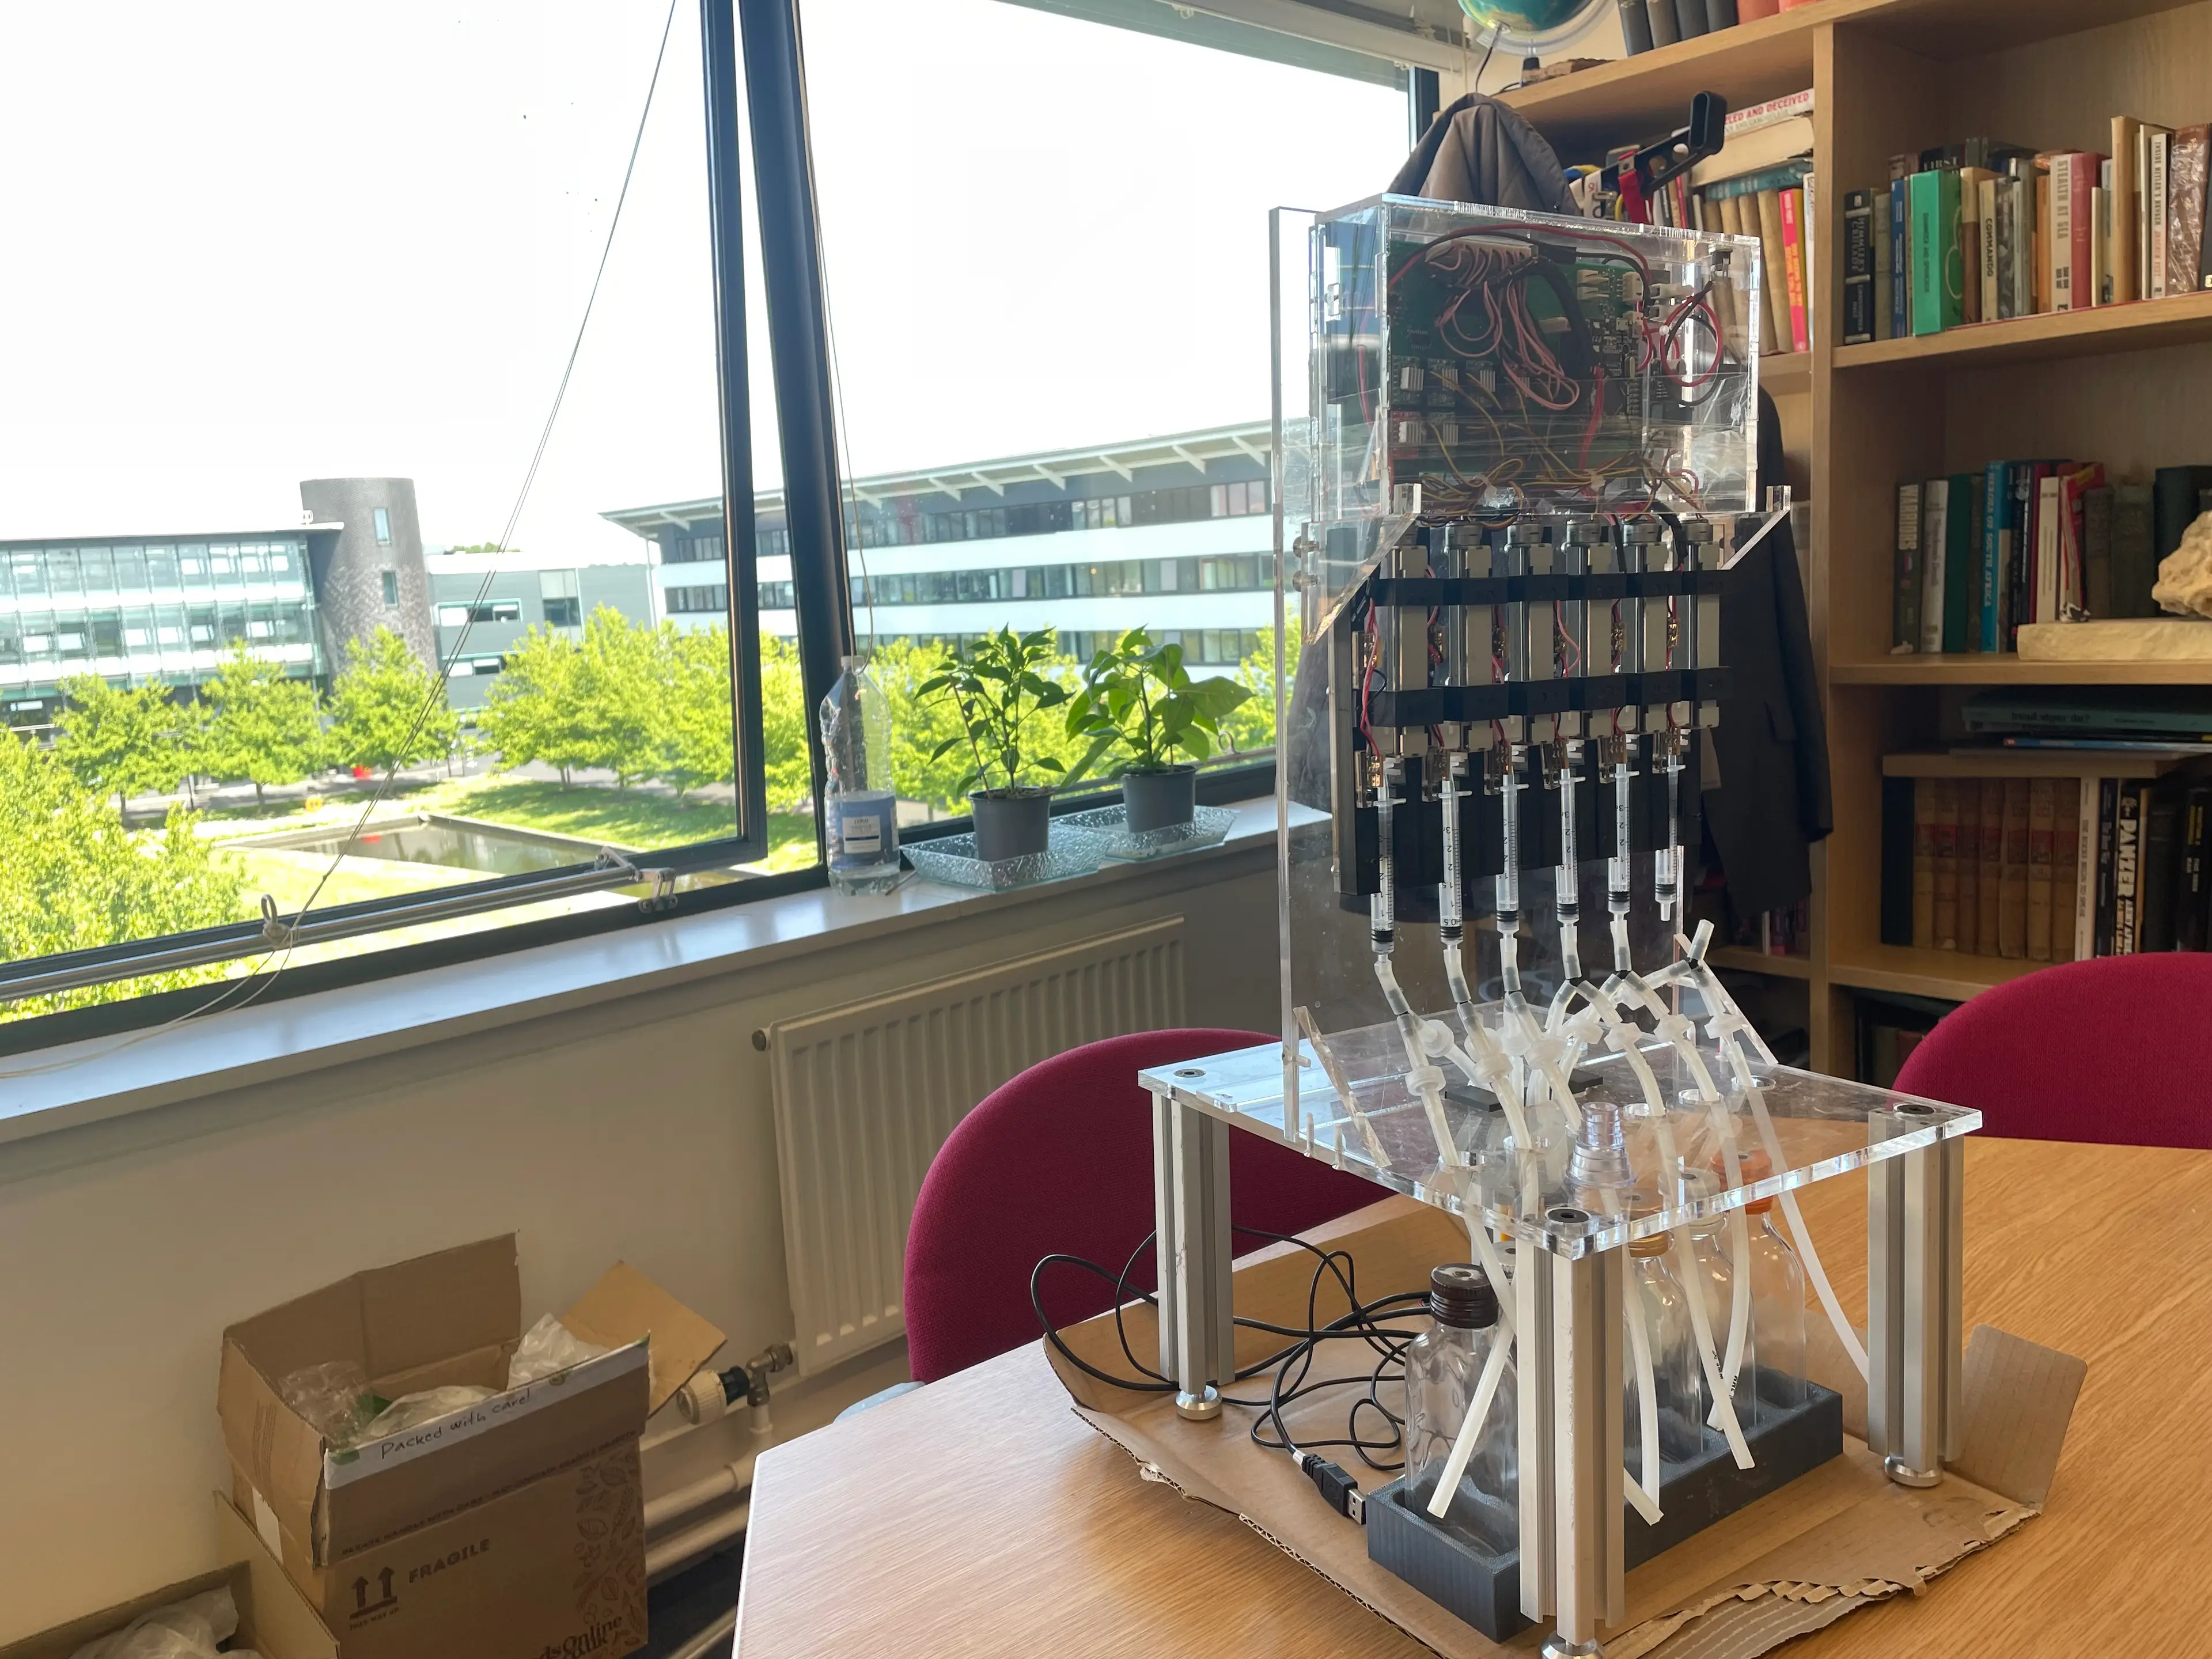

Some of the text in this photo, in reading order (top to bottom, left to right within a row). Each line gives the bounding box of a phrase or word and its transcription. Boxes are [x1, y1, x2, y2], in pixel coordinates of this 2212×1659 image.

[1747, 106, 1764, 118] AND
[1766, 93, 1809, 112] DECEIVED
[2057, 160, 2069, 239] STEALTH AT SEA
[1985, 218, 1994, 277] COMMANDO
[1899, 484, 1918, 550] WARRIORS
[1987, 515, 1993, 528] OF
[2118, 820, 2137, 897] PANZER
[381, 1426, 442, 1459] Packed
[450, 1411, 486, 1430] with
[342, 1536, 380, 1555] PLEASE
[384, 1520, 424, 1540] HANDLE
[427, 1508, 454, 1522] WITH
[408, 1538, 490, 1584] FRAGILE
[349, 1607, 400, 1631] THIS WAY UP
